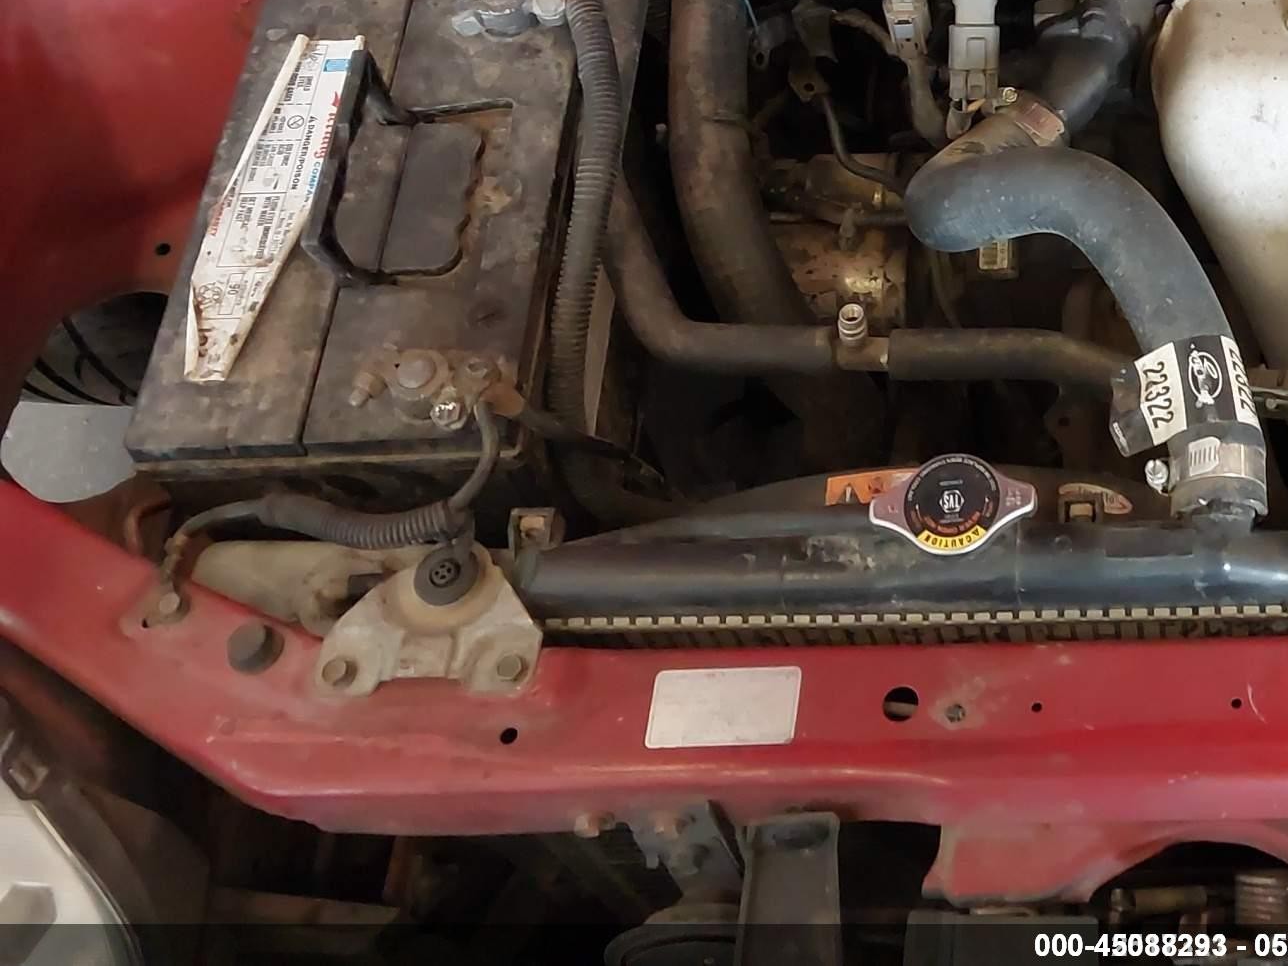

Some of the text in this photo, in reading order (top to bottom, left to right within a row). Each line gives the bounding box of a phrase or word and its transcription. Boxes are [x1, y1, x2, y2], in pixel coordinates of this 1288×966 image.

[291, 124, 315, 190] DANGER/POISON
[227, 284, 240, 294] 90
[1142, 360, 1175, 429] 22322
[924, 534, 974, 549] CAUTION
